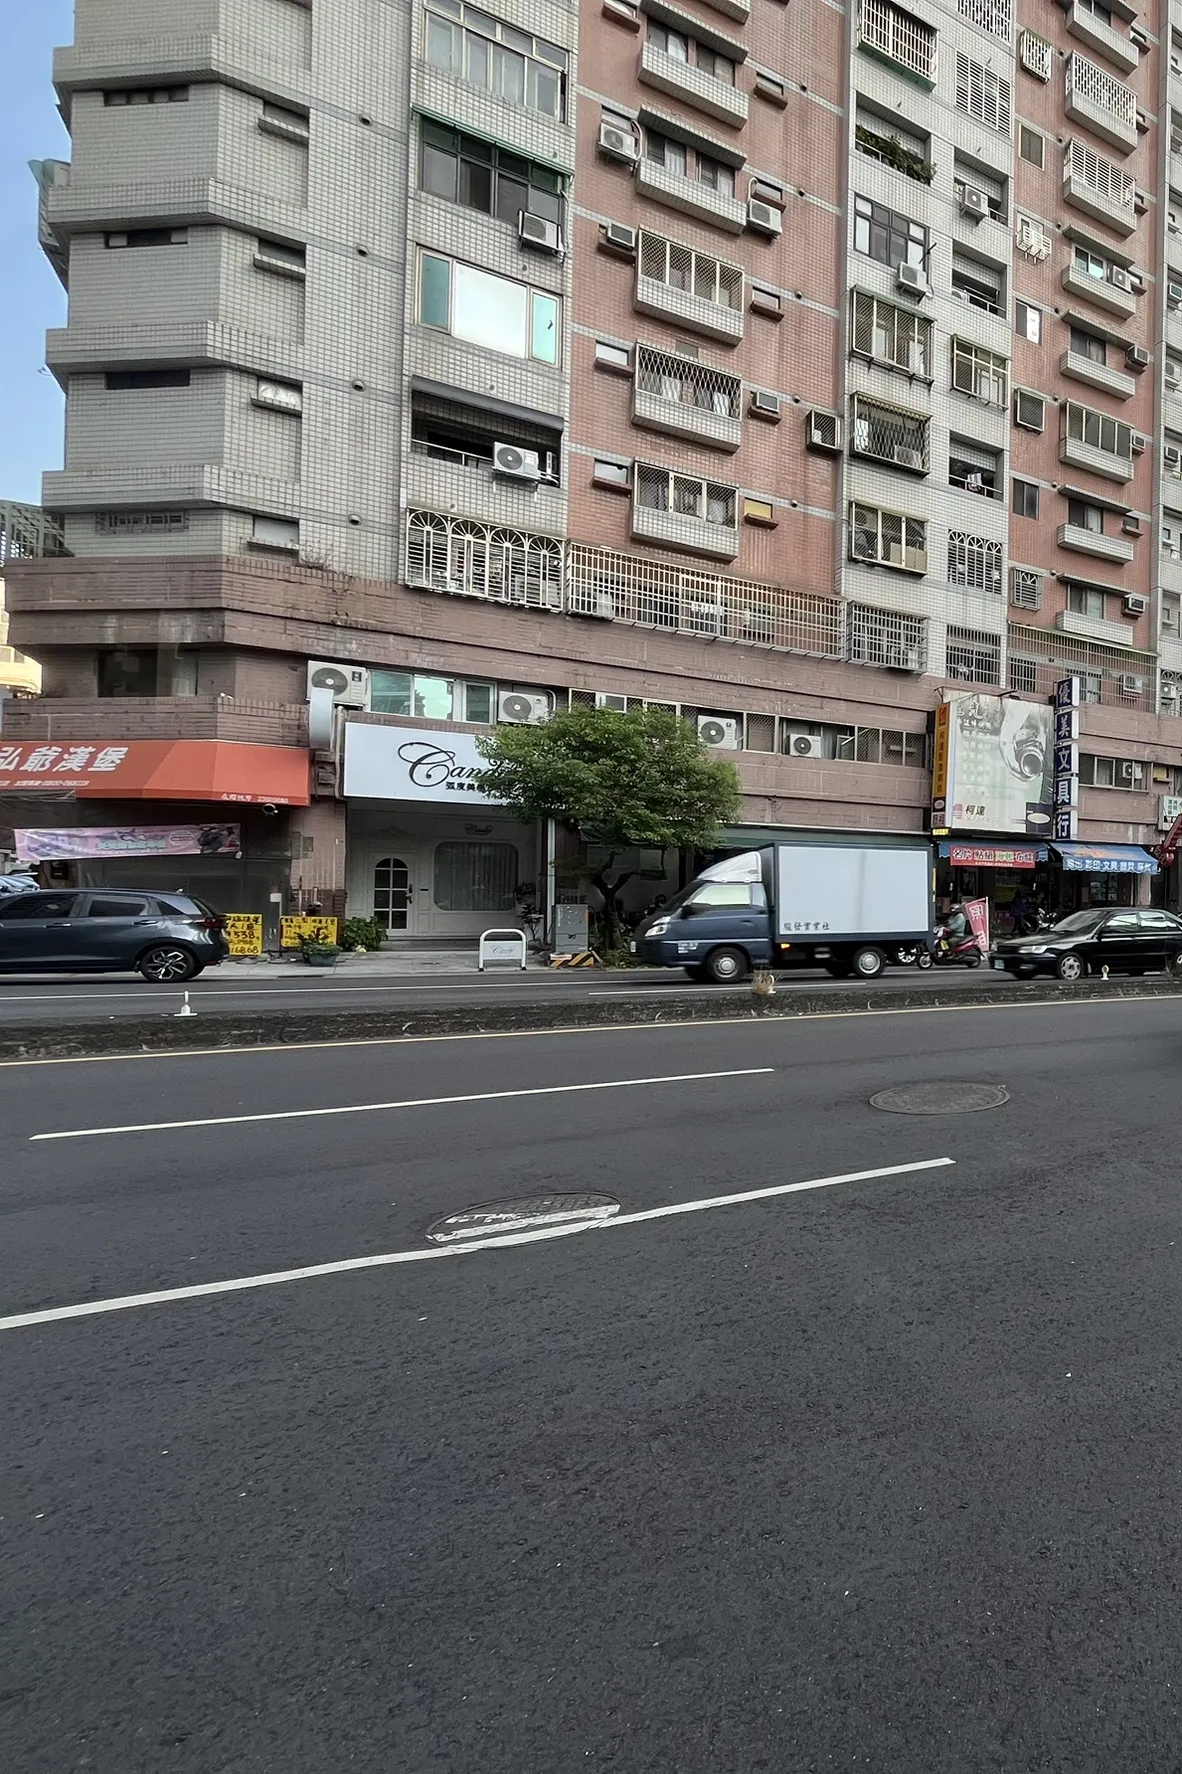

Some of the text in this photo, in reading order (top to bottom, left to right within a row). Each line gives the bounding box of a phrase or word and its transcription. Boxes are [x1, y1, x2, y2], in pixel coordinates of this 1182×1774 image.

[0, 747, 129, 772] 弘爺漢堡
[1057, 681, 1071, 837] 優美文具行
[965, 804, 986, 816] 柯達
[953, 848, 973, 860] 名片
